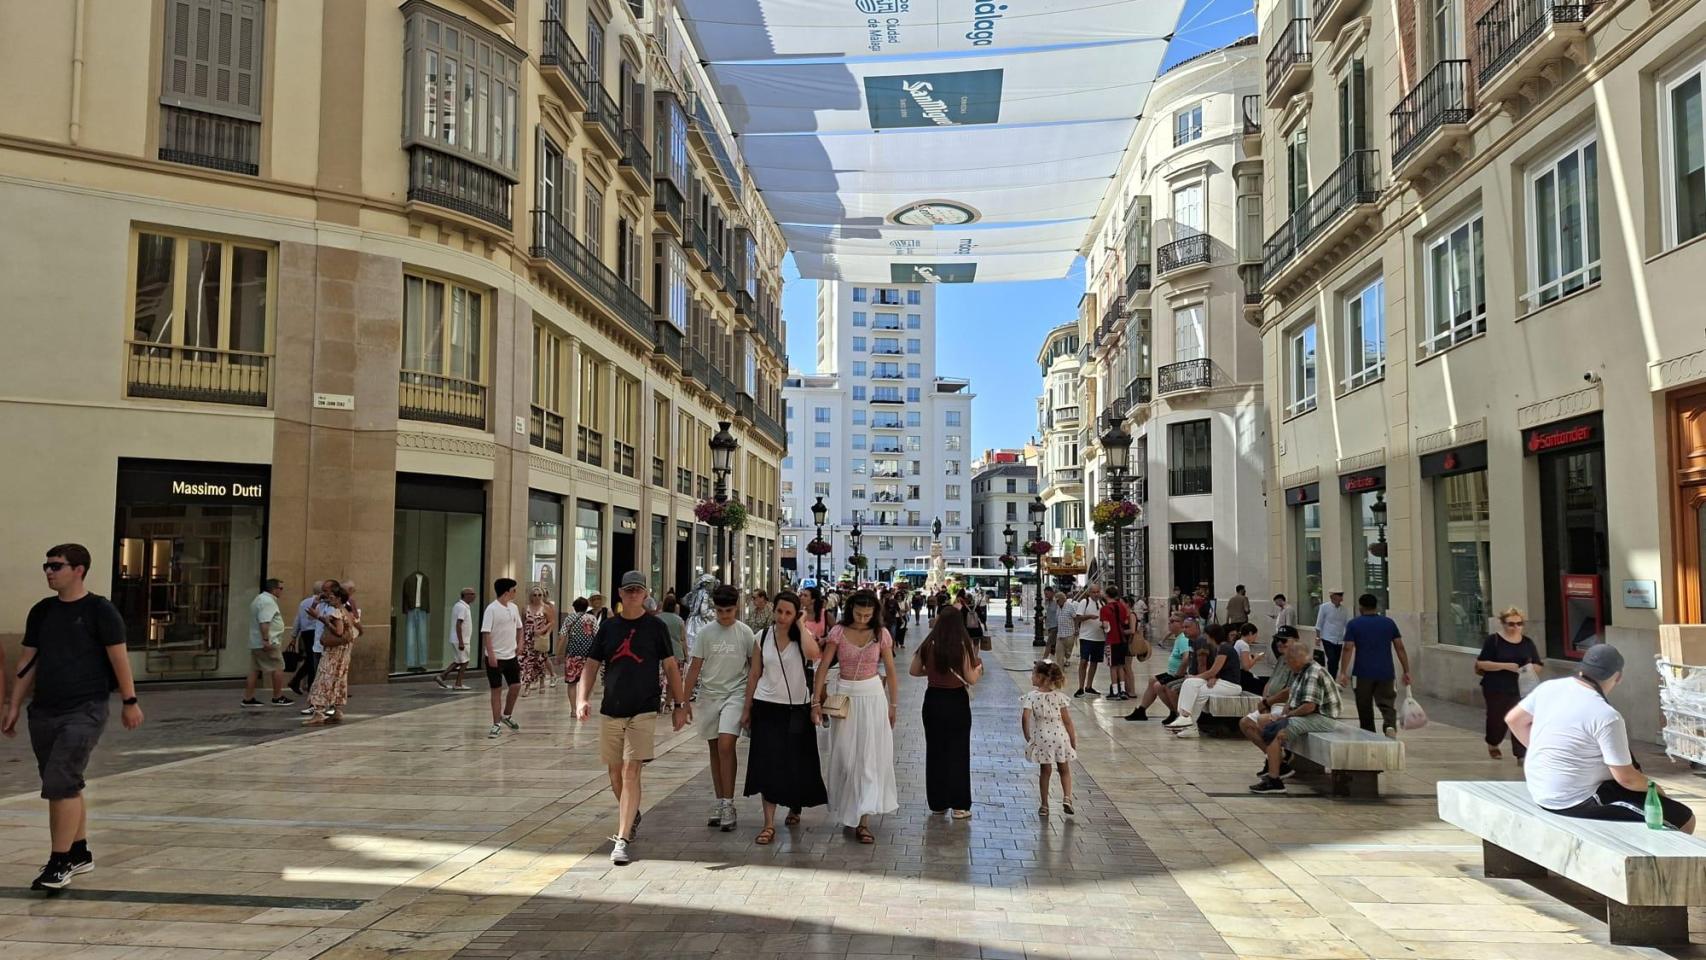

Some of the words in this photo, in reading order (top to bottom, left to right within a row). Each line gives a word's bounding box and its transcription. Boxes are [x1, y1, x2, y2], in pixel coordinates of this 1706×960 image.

[867, 19, 880, 28] de
[886, 18, 900, 44] Ciudad
[1540, 426, 1592, 449] Santander
[172, 481, 226, 496] Massimo
[232, 483, 262, 497] Dutti
